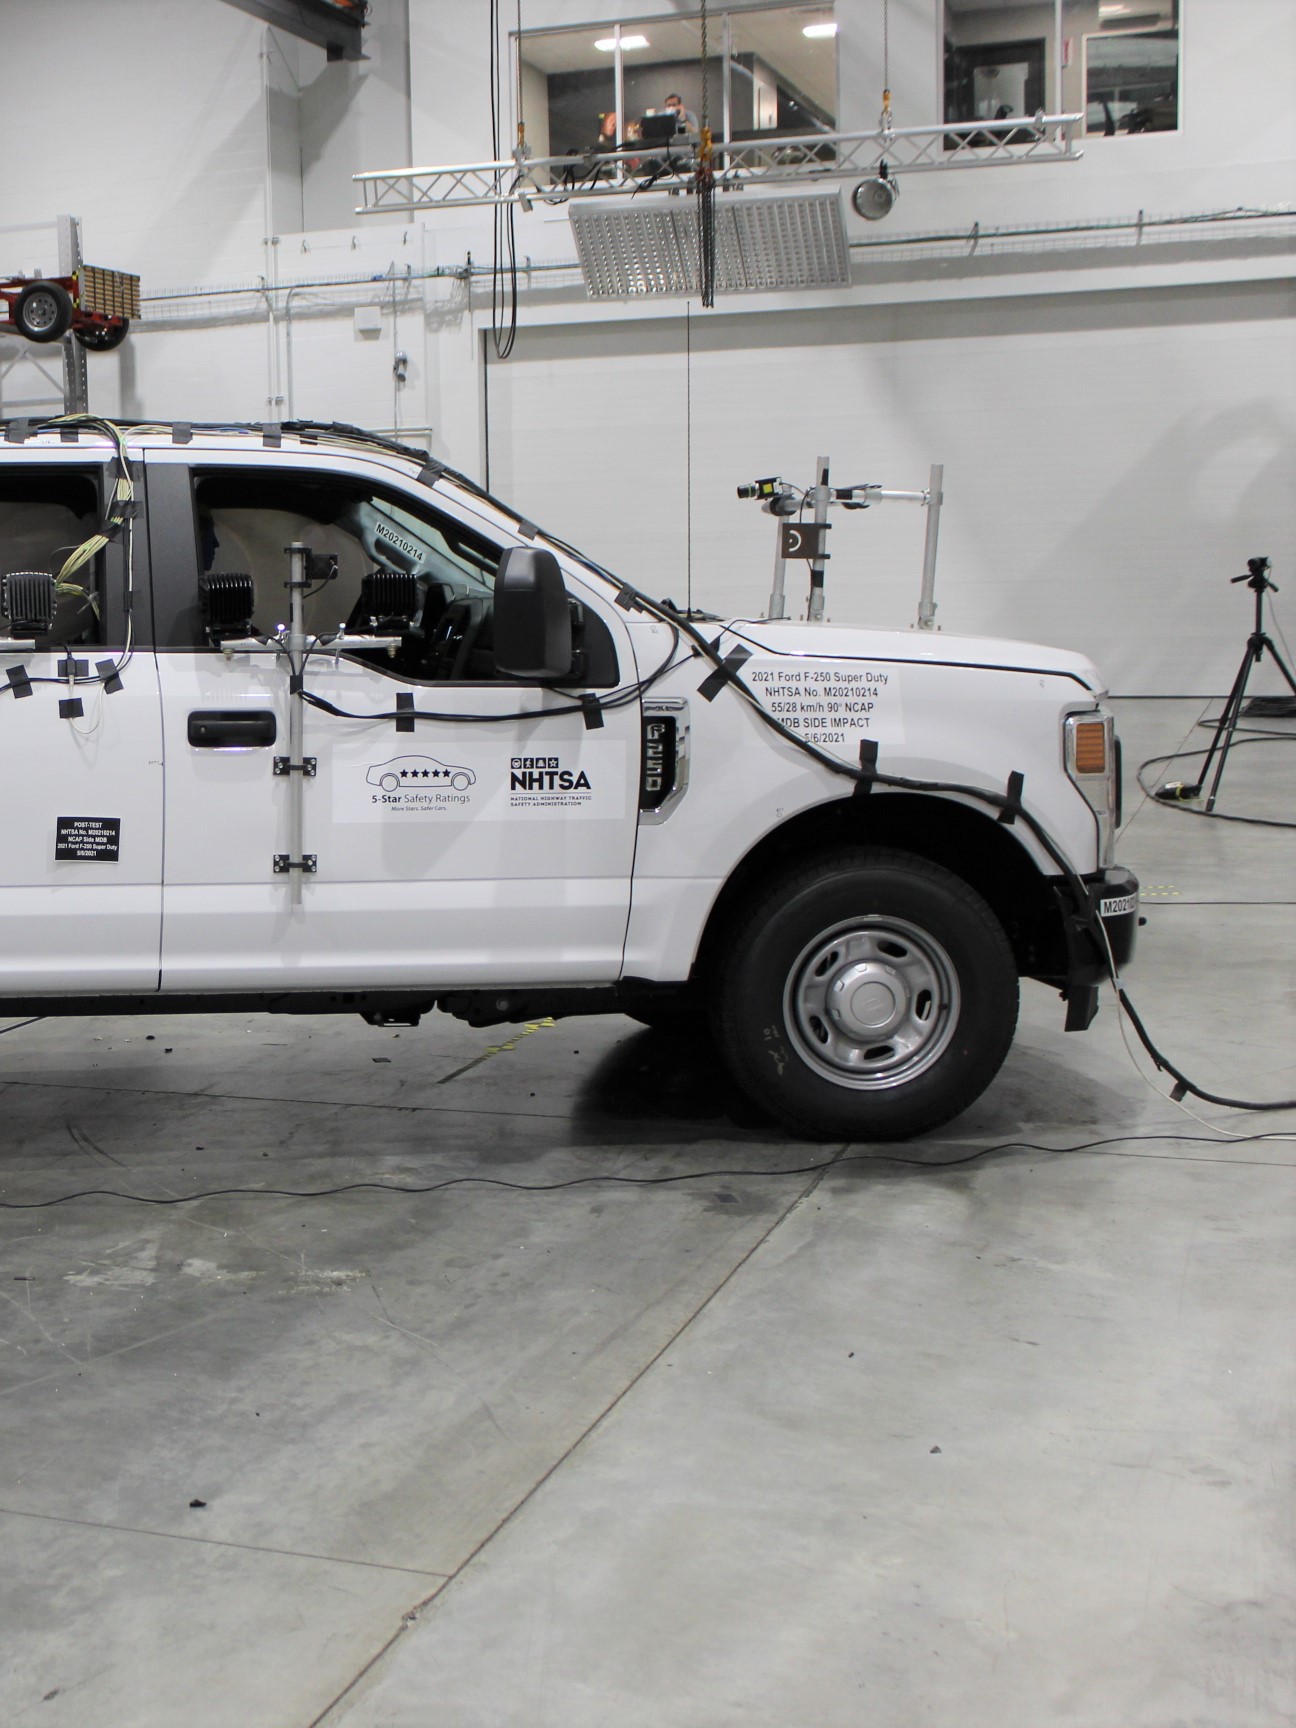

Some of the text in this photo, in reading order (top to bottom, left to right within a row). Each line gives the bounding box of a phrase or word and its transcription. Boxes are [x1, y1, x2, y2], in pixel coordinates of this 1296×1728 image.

[376, 523, 423, 561] M20210214
[752, 672, 888, 685] 2021 Ford F-250 Super Duty
[765, 687, 878, 697] NHTSA No. M20210214
[771, 702, 797, 712] 55/28
[800, 702, 824, 712] km/h
[845, 702, 874, 712] NCAP
[803, 717, 827, 728] SIDE
[831, 717, 870, 728] IMPACT
[804, 732, 845, 743] 5/6/2021
[646, 723, 665, 791] F250
[510, 770, 592, 791] NHTSA
[371, 793, 471, 805] 5-Star Safety Ratings
